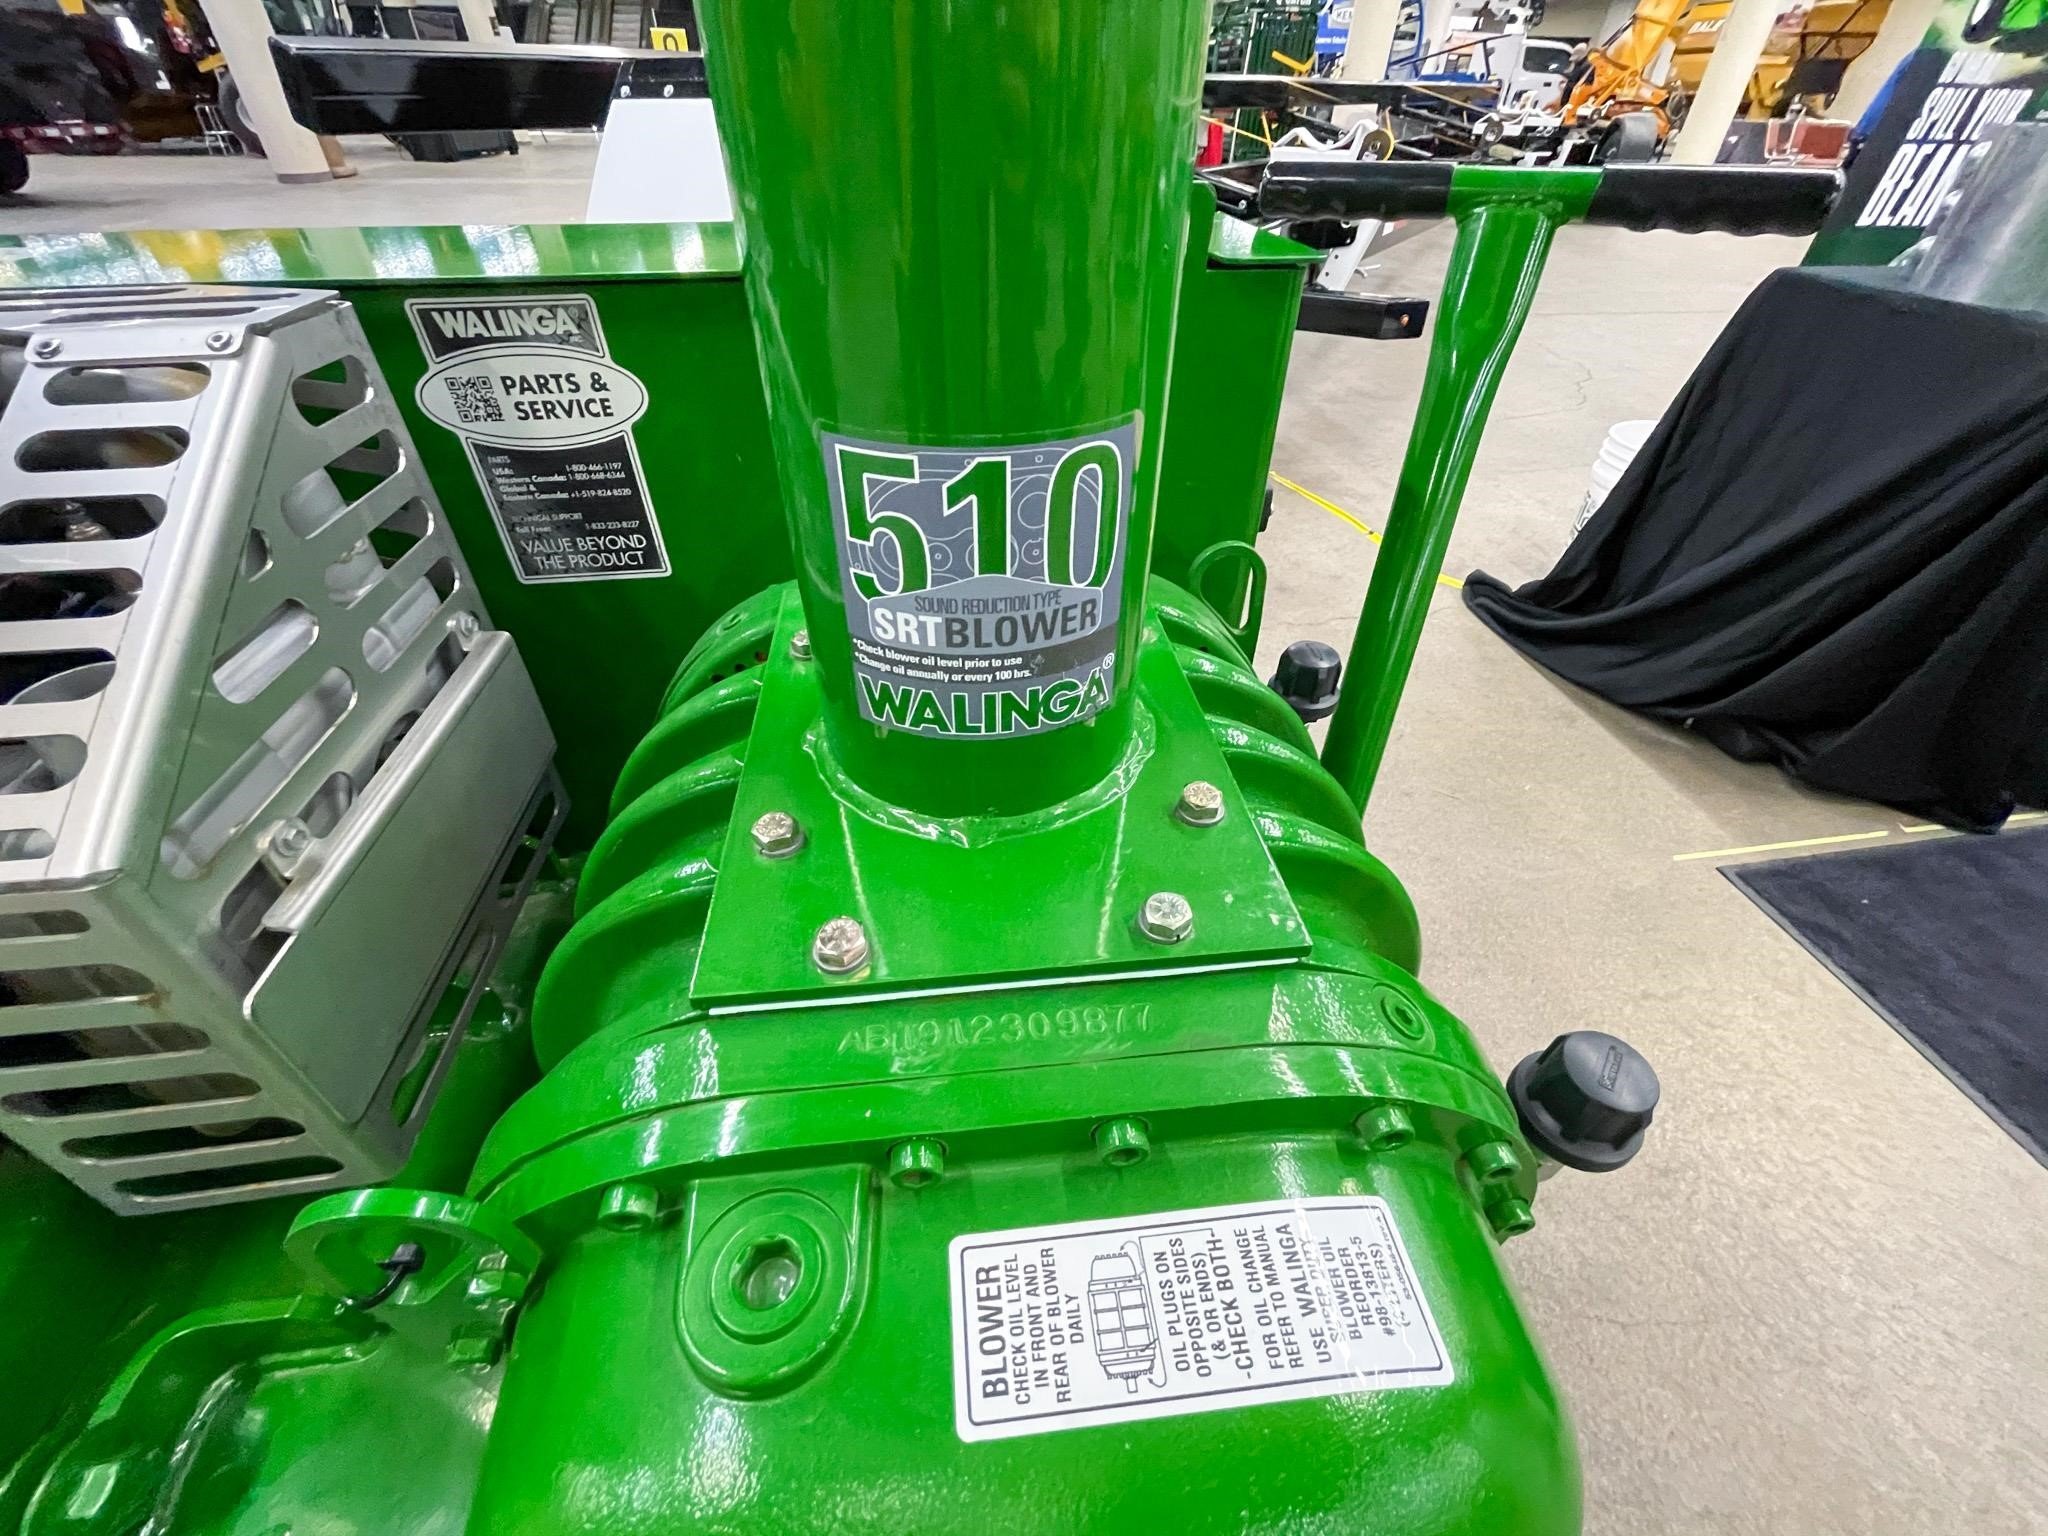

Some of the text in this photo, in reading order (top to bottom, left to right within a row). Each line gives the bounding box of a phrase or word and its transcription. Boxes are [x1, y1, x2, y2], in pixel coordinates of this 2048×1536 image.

[1905, 87, 2034, 141] SPILL YOUR
[1855, 141, 1992, 227] BEAN
[500, 371, 611, 396] PARTS &
[514, 398, 614, 420] SERVICE
[520, 534, 646, 554] VALUE BEYOND
[534, 551, 644, 570] THE PRODUCT
[834, 440, 1122, 603] 510
[914, 589, 1062, 615] SOUND REDUCTION TYPE
[885, 648, 920, 664] blower
[921, 656, 935, 666] oil
[937, 656, 963, 668] level
[964, 657, 990, 670] prior
[991, 658, 1002, 667] to
[1004, 657, 1023, 666] use
[892, 664, 905, 675] oil
[906, 668, 949, 683] annually
[951, 673, 963, 681] or
[964, 673, 993, 683] every
[994, 669, 1012, 680] 100
[1013, 669, 1032, 679] hrs.
[975, 1264, 1009, 1398] BLOWER
[1004, 1254, 1030, 1405] CHECK OIL LEVEL
[1023, 1264, 1049, 1388] IN FRONT AND
[1041, 1247, 1071, 1403] REAR OF BLOWER
[1064, 1294, 1084, 1344] DAILY
[1153, 1251, 1190, 1372] OIL PLUGS ON
[1169, 1238, 1212, 1377] OPPOSITE SIDES
[1191, 1253, 1230, 1360] (& OR ENDS)
[1234, 1228, 1284, 1369] FOR OIL CHANGE
[1251, 1225, 1304, 1368] REFER TO MANUAL
[1275, 1223, 1332, 1364] USE WALINGA
[1318, 1236, 1362, 1340] BLOWER OIL
[1338, 1247, 1375, 1326] REORDER
[1350, 1236, 1396, 1336] #98-13813-5
